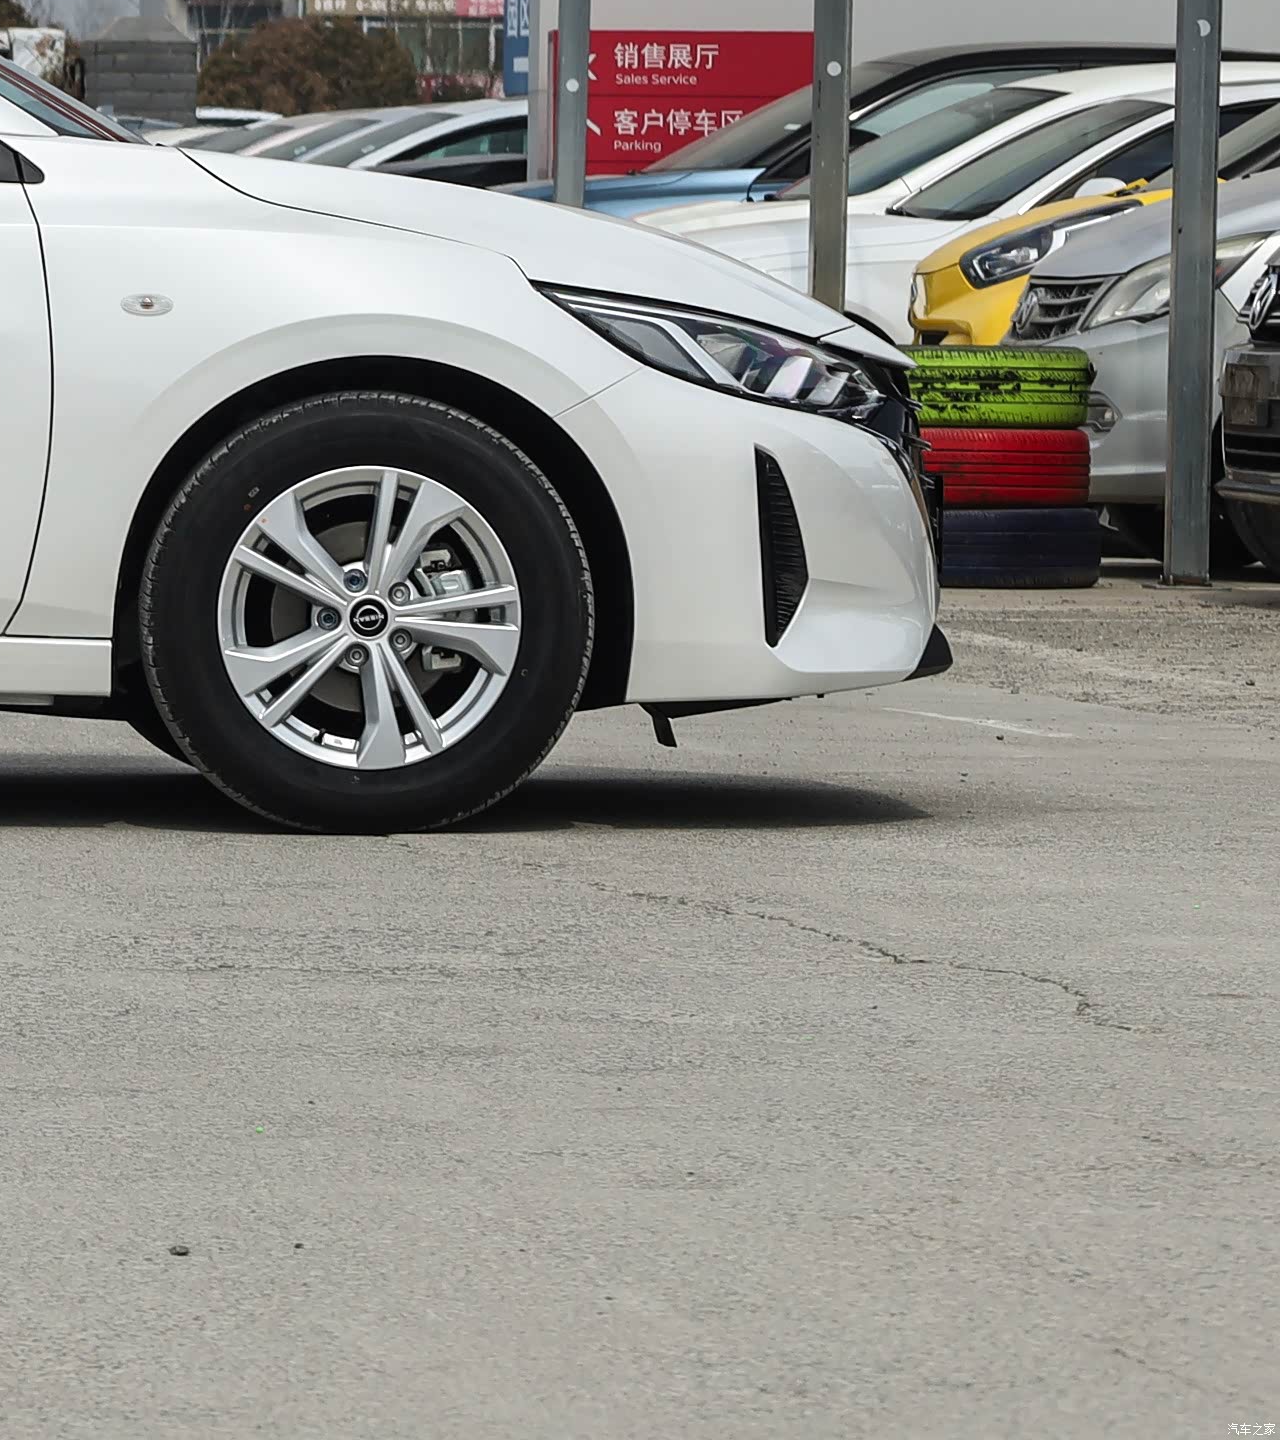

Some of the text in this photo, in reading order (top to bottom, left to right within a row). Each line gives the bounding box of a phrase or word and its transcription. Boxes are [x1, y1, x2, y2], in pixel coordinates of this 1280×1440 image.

[614, 42, 719, 69] 销售展厅
[615, 73, 698, 85] Sales Service
[614, 140, 662, 152] Parking
